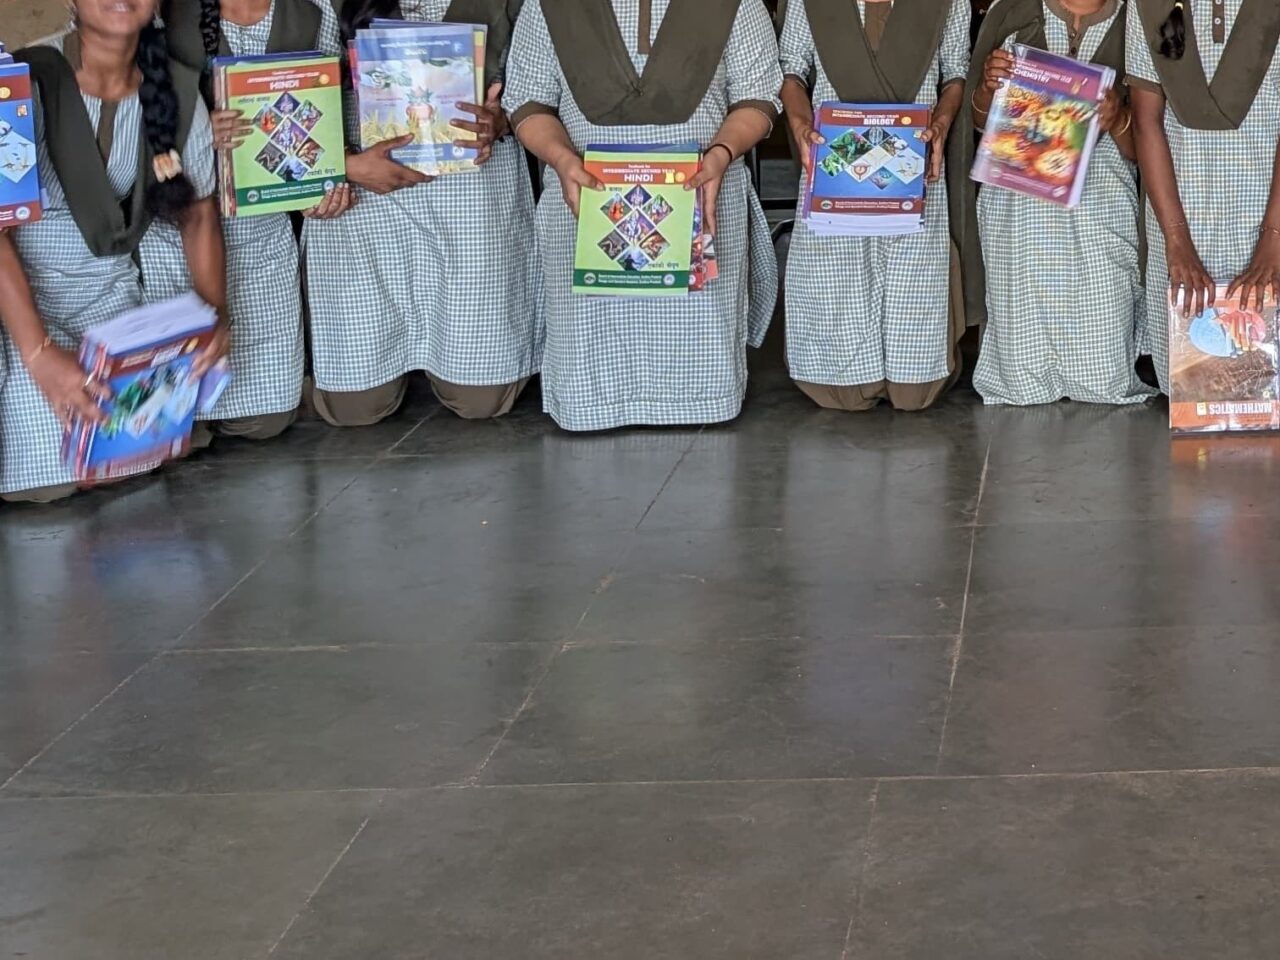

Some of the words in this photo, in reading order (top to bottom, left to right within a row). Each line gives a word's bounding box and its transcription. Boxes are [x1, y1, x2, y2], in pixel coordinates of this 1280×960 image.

[269, 79, 299, 91] HINDI
[624, 173, 654, 182] HINDI
[1208, 402, 1273, 415] MATHEMATICS
